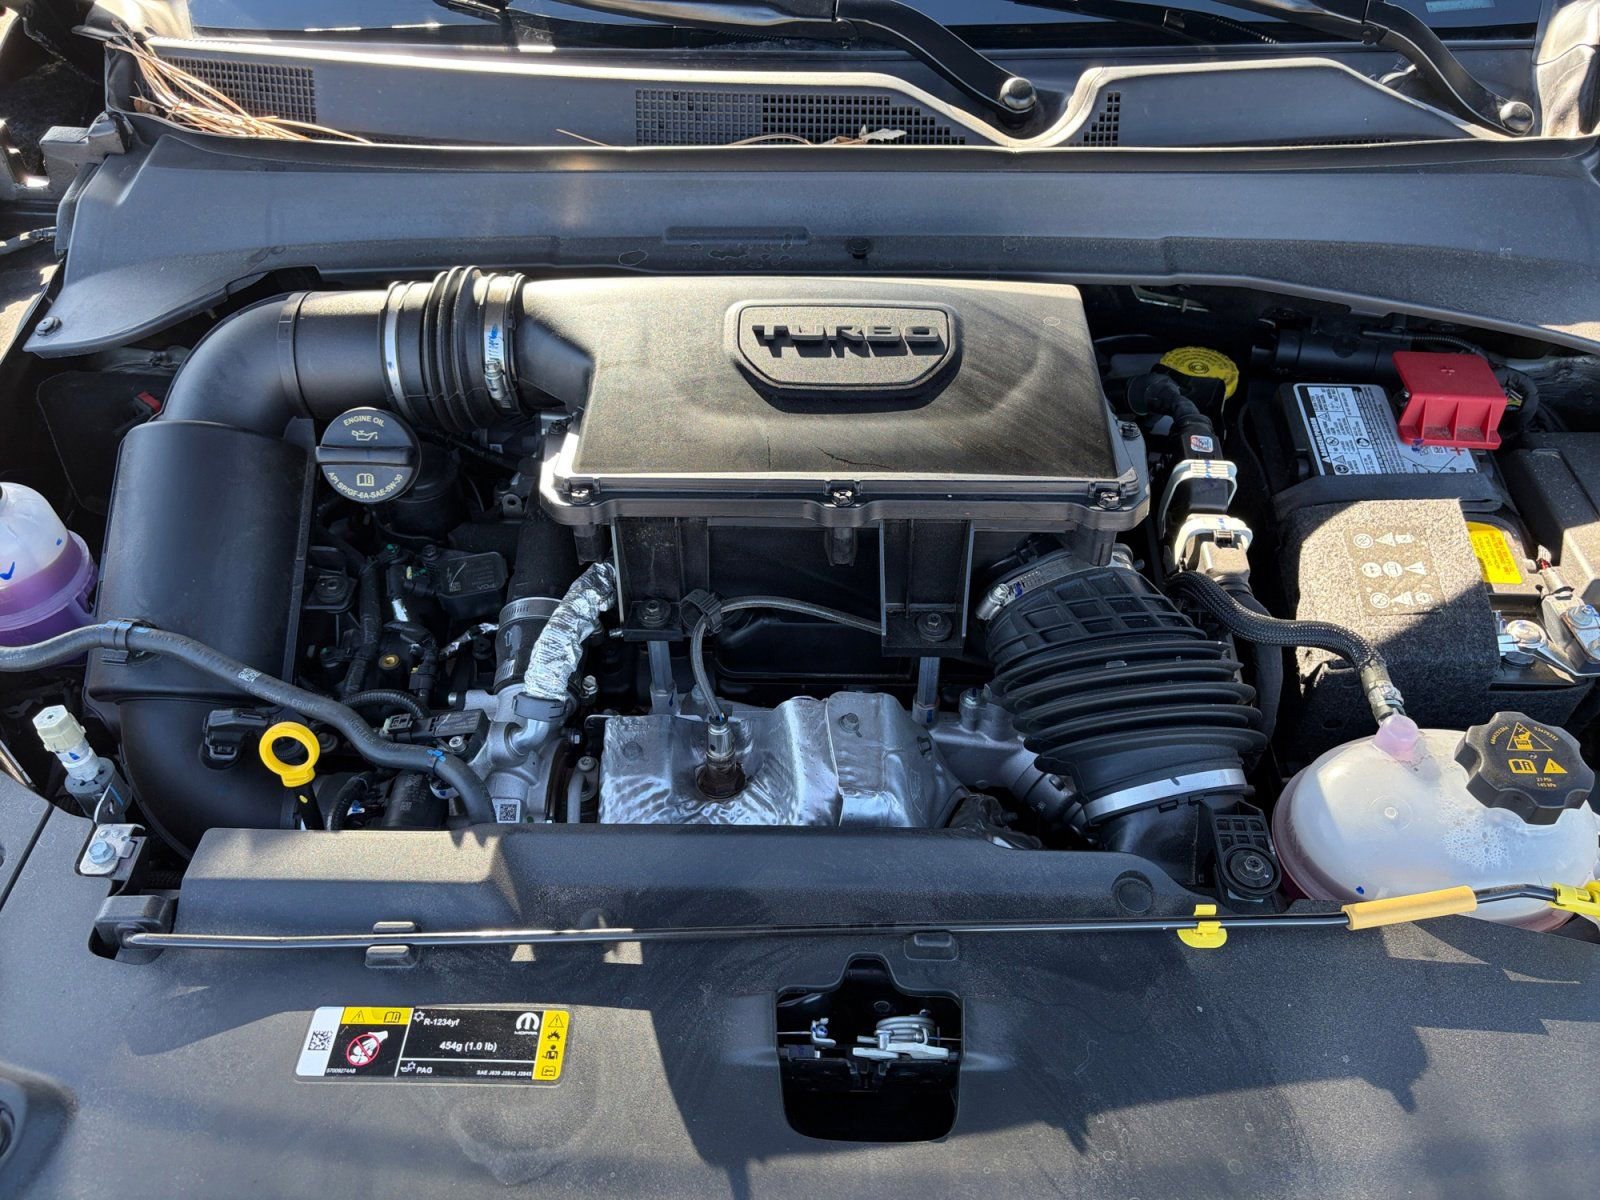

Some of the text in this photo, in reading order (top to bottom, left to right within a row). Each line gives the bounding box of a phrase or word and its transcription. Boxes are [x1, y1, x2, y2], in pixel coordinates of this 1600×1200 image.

[751, 324, 940, 343] TURBO
[343, 415, 385, 427] ENGINE OIL
[327, 471, 339, 486] API
[423, 1017, 460, 1027] R-1234yf
[439, 1041, 498, 1053] 454g (1.0 lb)
[416, 1066, 433, 1074] PAG
